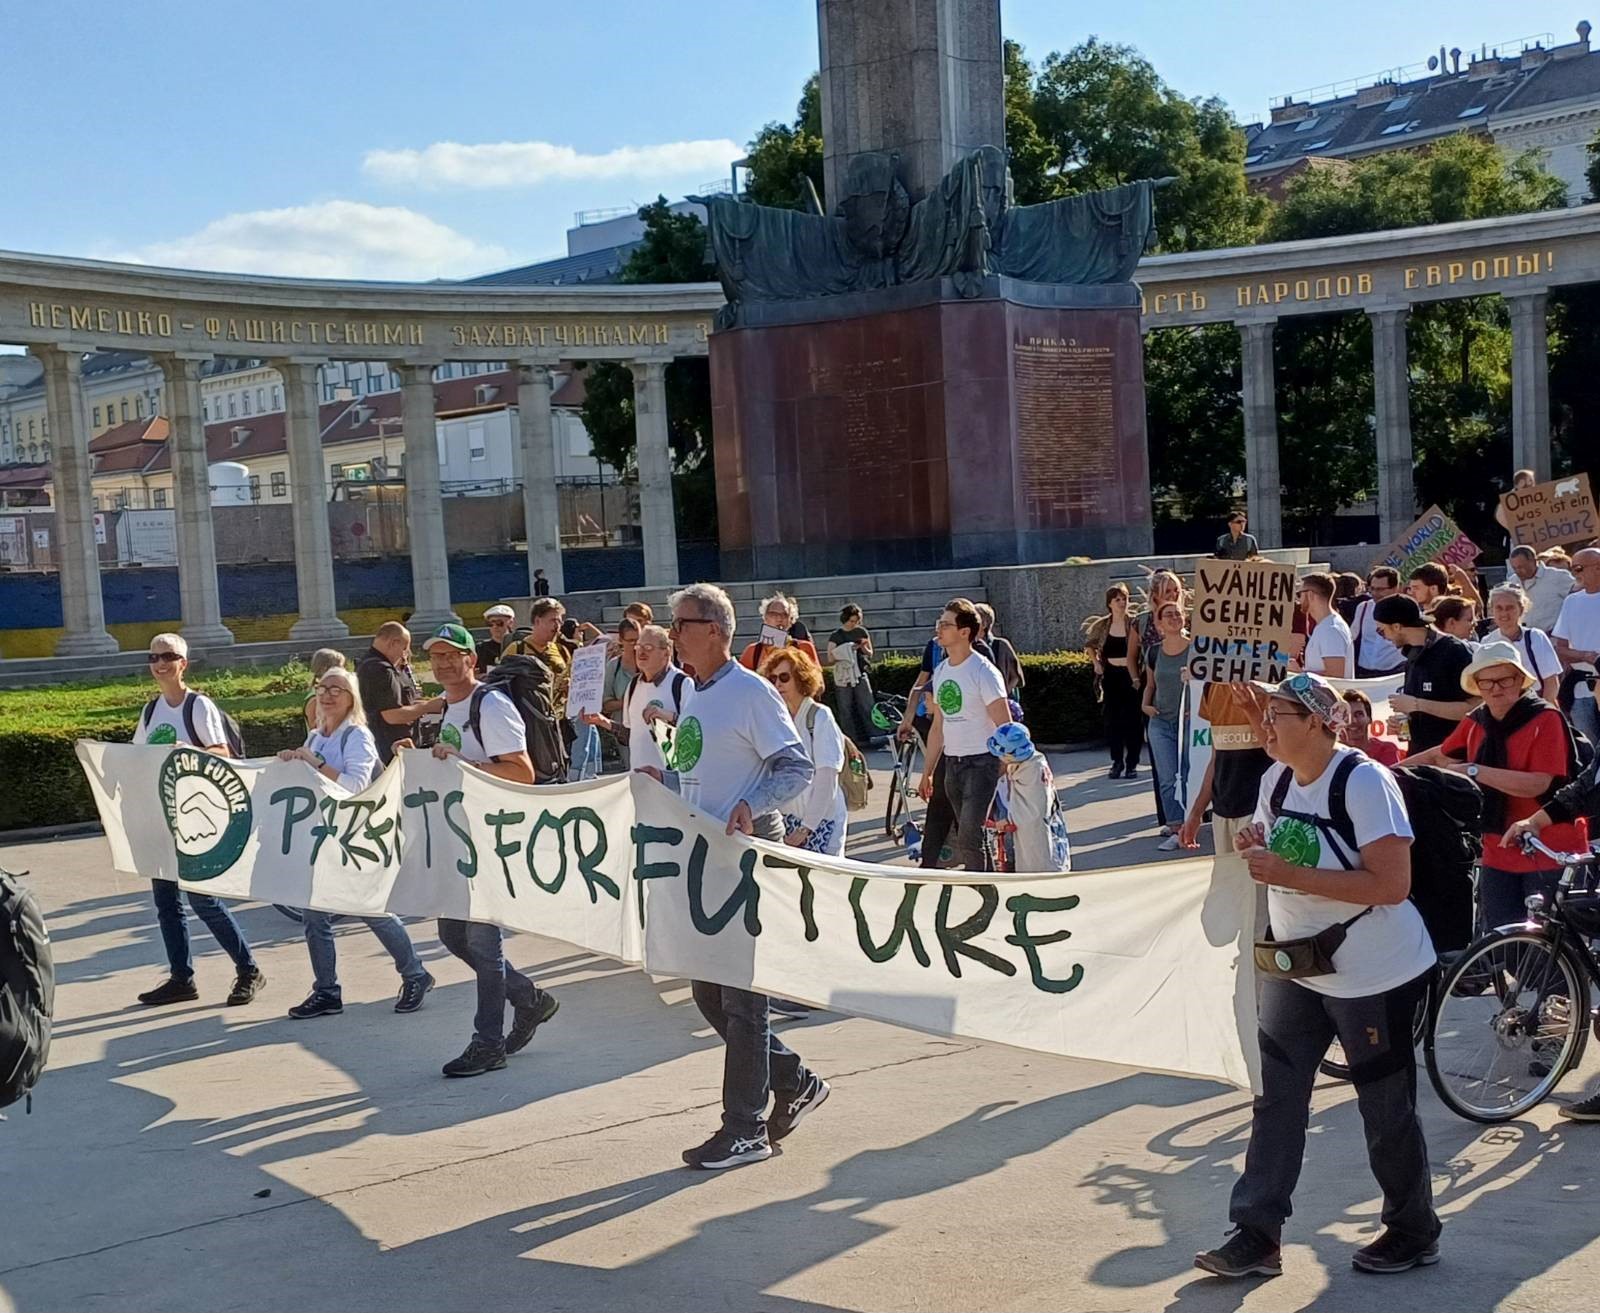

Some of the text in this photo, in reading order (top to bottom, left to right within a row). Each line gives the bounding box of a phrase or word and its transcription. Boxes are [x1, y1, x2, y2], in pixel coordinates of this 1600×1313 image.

[1236, 273, 1372, 307] НАРОДОВ
[1404, 251, 1553, 289] ЕВРОПЫ!
[452, 323, 669, 347] ЗАХВАТЧИКАМИ
[695, 322, 708, 345] З
[1516, 495, 1589, 521] was ist ein
[1400, 514, 1445, 556] WORLD
[1515, 510, 1594, 545] Eisbär?
[1200, 564, 1294, 602] WÄHLEN
[1200, 599, 1283, 627] GEHEN
[1228, 625, 1261, 637] STATT
[1194, 635, 1279, 660] UNTER
[1190, 656, 1287, 684] GEHEN
[173, 753, 199, 774] FOR
[204, 757, 248, 814] FUTURE
[484, 806, 620, 904] FOR
[631, 823, 1084, 993] FUTURE
